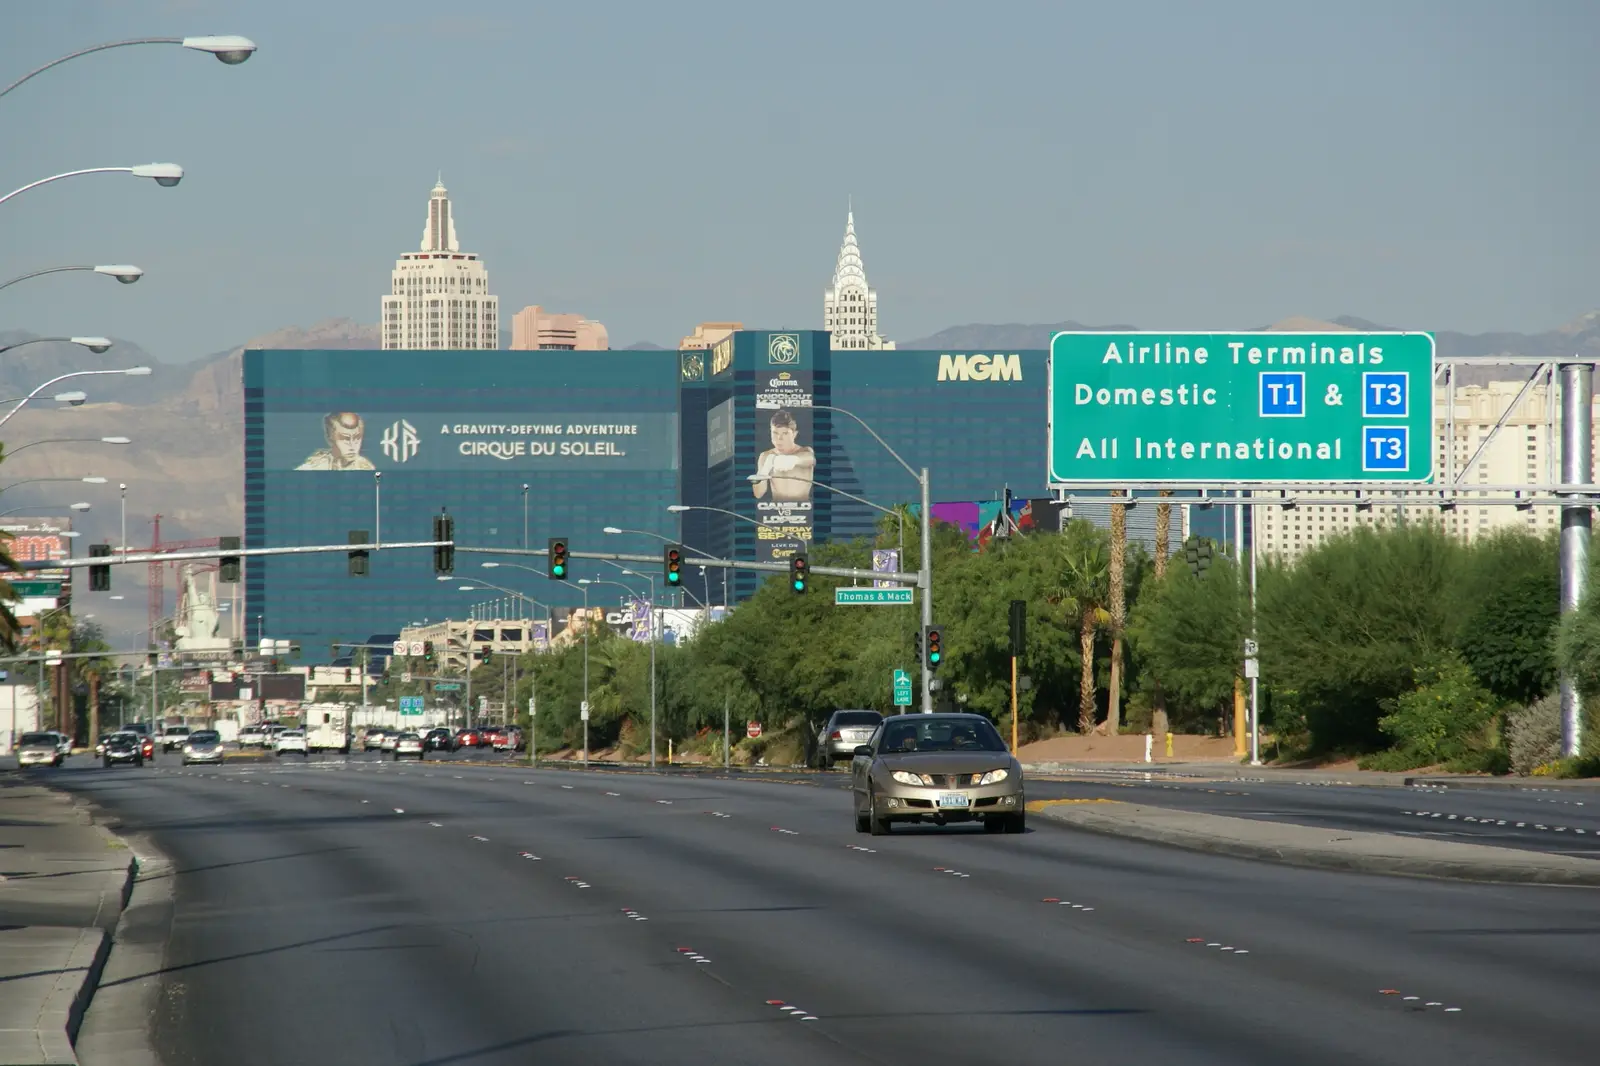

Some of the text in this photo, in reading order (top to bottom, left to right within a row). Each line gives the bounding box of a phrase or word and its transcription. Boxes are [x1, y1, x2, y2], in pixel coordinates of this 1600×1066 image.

[1102, 342, 1384, 364] Airline Terminals
[937, 354, 1023, 381] MGM
[1074, 383, 1402, 406] Domestic T1 & T3
[440, 424, 638, 435] A GRAVITY-DEFYING ADVENTURE
[459, 441, 525, 460] CIRQUE
[531, 442, 555, 456] DU
[1076, 437, 1402, 460] All International T3
[838, 592, 911, 600] Thomas & Mack
